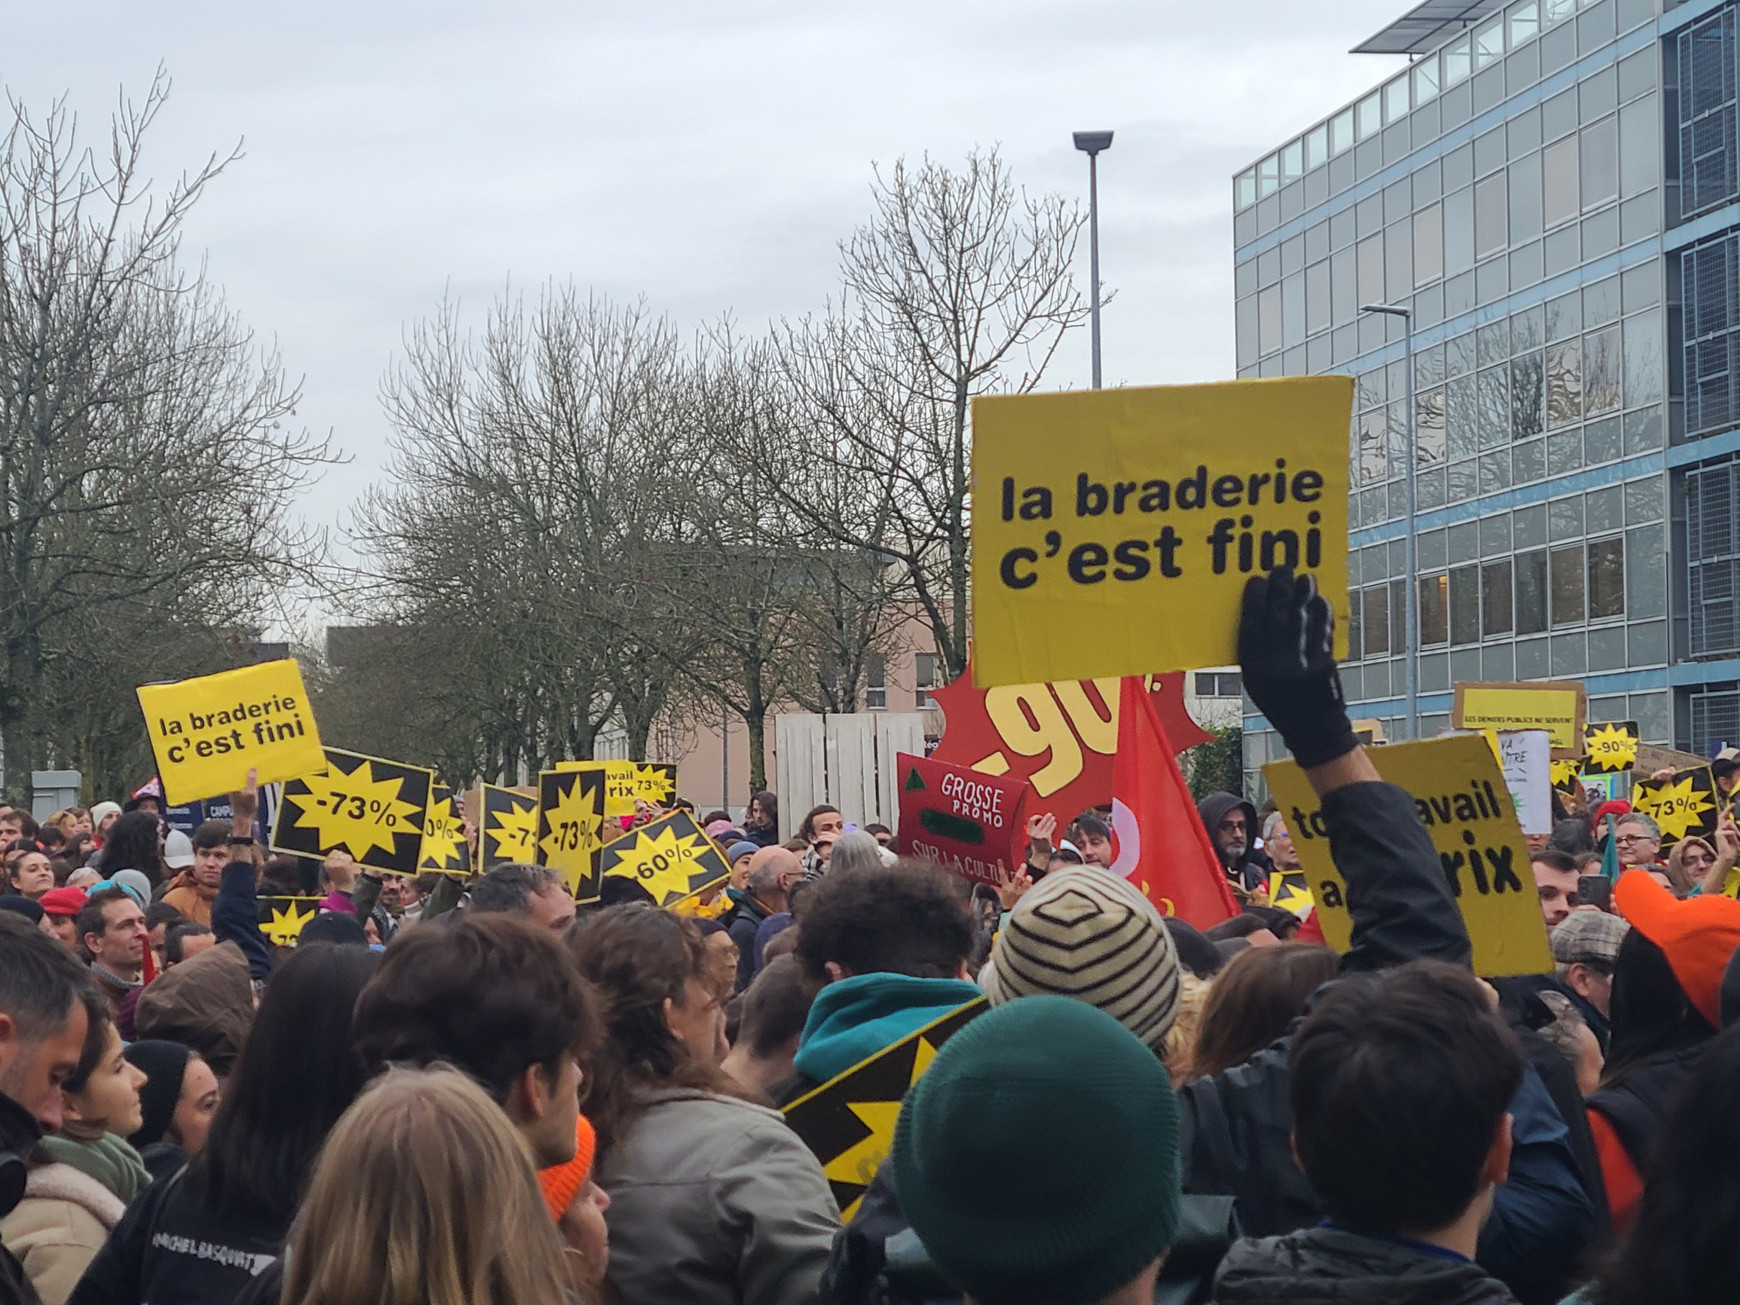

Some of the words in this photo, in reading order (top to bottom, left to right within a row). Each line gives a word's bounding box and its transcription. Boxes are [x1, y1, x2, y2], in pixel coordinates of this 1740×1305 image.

[1002, 477, 1052, 521] la
[1076, 458, 1324, 516] braderie
[1207, 510, 1322, 574] fini
[159, 718, 183, 736] la
[189, 694, 296, 730] braderie
[252, 713, 304, 745] fini
[1597, 740, 1634, 753] -90%
[316, 791, 397, 827] -73%
[942, 773, 1004, 813] GROSSE
[953, 800, 1003, 828] PROMO
[554, 818, 593, 851] -73%
[637, 843, 692, 880] 60%
